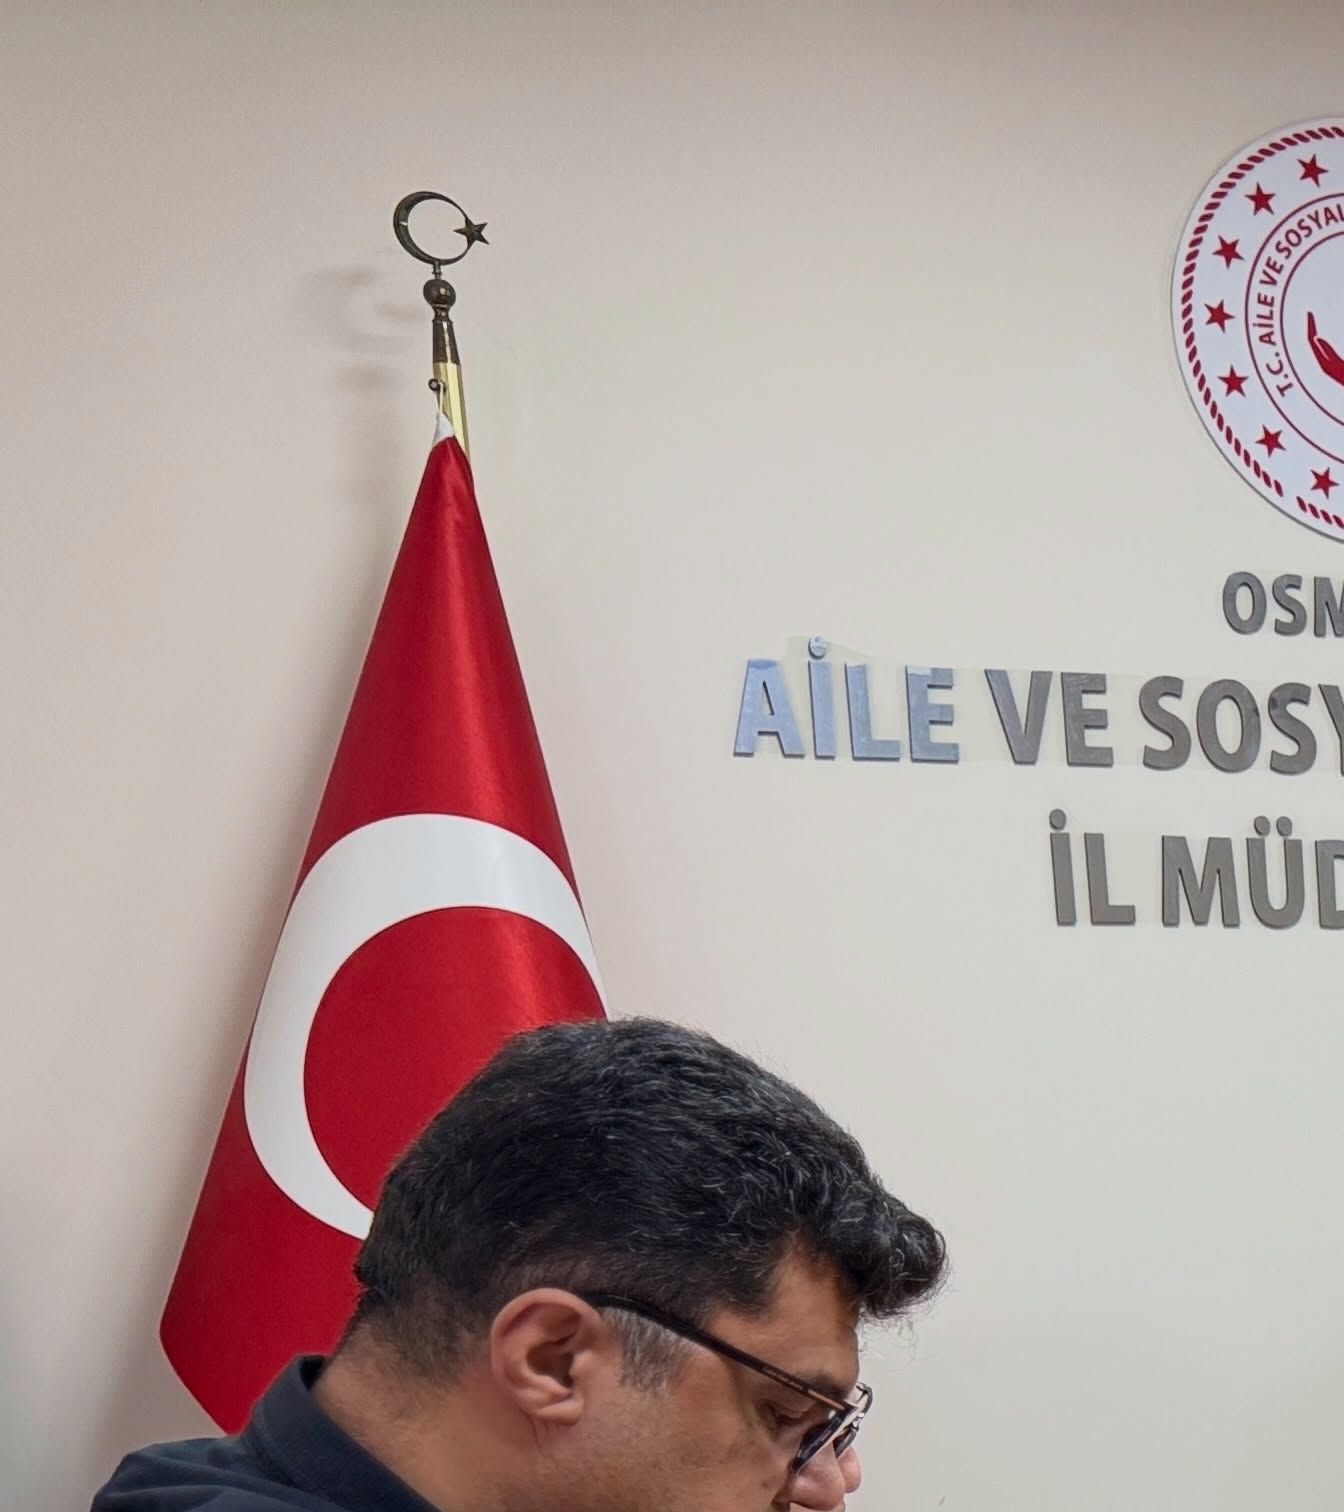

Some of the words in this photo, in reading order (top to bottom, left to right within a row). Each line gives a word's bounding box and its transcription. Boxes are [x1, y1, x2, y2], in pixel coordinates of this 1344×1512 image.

[1259, 256, 1285, 287] VE
[1252, 292, 1277, 346] AİLE
[1266, 351, 1294, 398] T.C.
[733, 636, 960, 764] AİLE
[984, 668, 1114, 768] VE
[1049, 808, 1136, 928] İL
